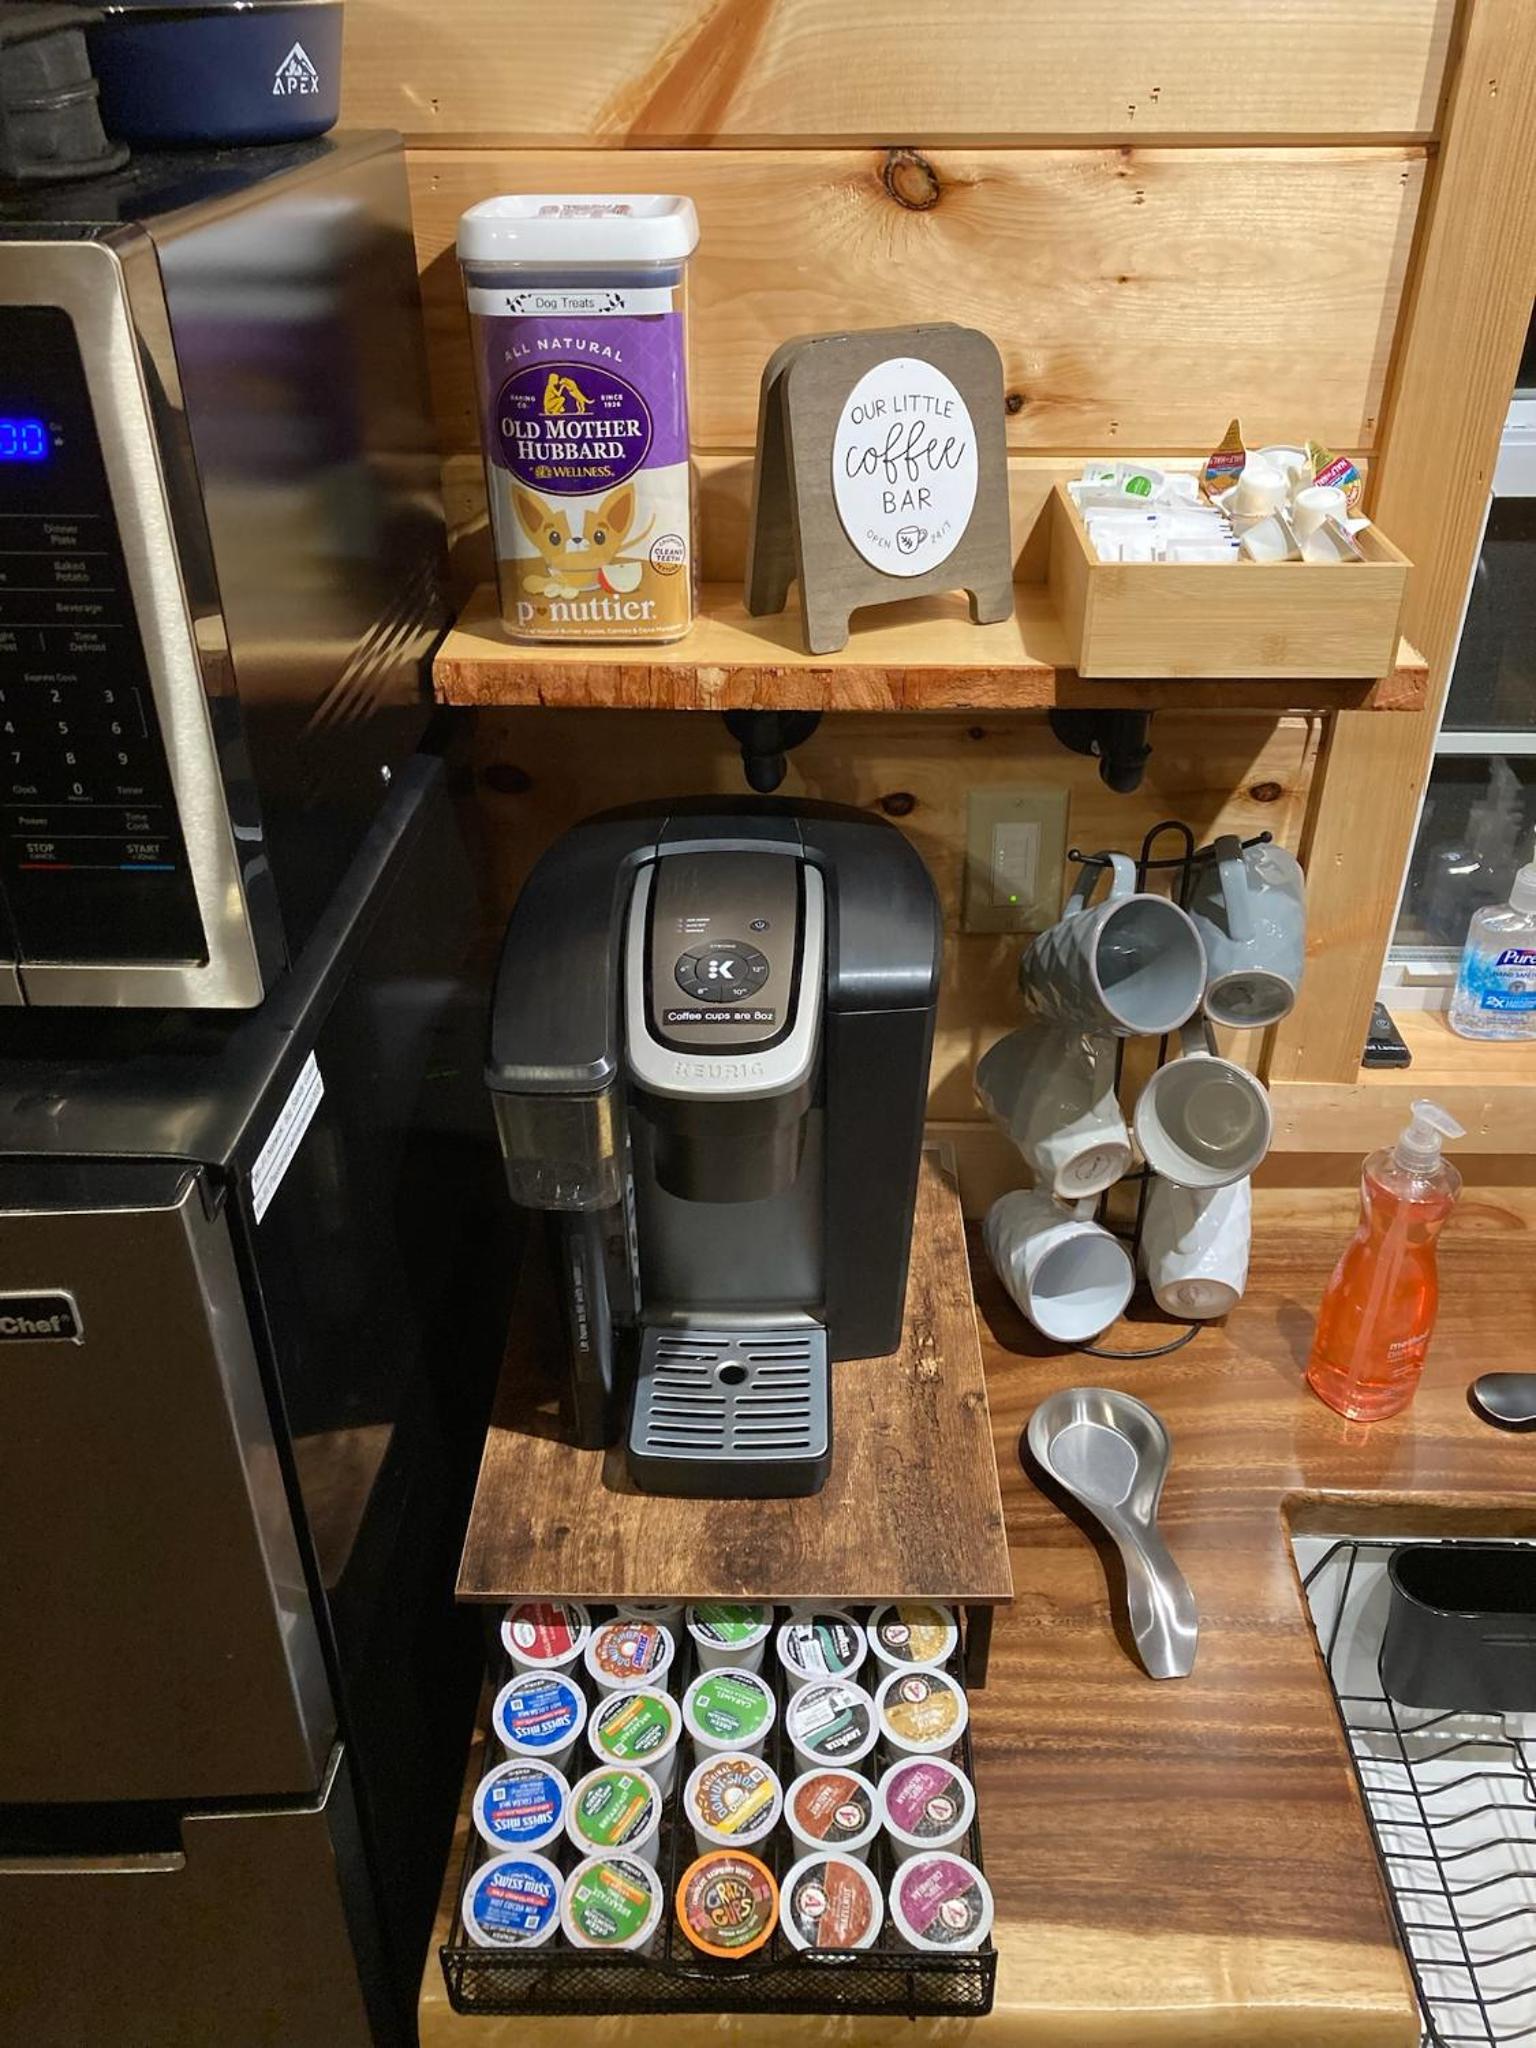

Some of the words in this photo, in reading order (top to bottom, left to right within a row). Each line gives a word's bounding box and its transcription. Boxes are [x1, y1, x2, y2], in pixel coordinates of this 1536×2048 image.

[272, 75, 319, 95] APEX
[535, 297, 558, 311] Dog
[560, 297, 595, 309] Treats
[504, 344, 531, 362] ALL
[537, 337, 623, 363] NATURAL
[851, 399, 887, 425] OUR
[893, 394, 955, 419] LITTLE
[502, 417, 540, 440] OLD
[545, 419, 642, 440] MOTHER
[846, 420, 966, 485] coffee
[882, 487, 933, 514] BAR
[866, 528, 892, 550] OPEN
[56, 603, 103, 614] Beverage
[50, 690, 61, 702] 2
[104, 690, 114, 703] 3
[4, 721, 15, 733] 4
[59, 722, 68, 734] 5
[112, 722, 121, 734] 6
[12, 752, 21, 764] 7
[66, 753, 76, 765] 8
[119, 753, 128, 765] 9
[12, 786, 38, 795] Clock
[73, 783, 83, 795] 0
[127, 822, 150, 831] Cook
[26, 844, 55, 853] STOP
[126, 844, 160, 853] START
[668, 1012, 702, 1021] Coffee
[705, 1013, 731, 1022] cups
[734, 1012, 751, 1021] are
[675, 1061, 765, 1080] KEURIG
[0, 1315, 61, 1334] Chef
[714, 1691, 752, 1708] CARAMEL
[702, 1766, 731, 1790] ORIGINAL
[498, 1800, 511, 1808] MIX
[511, 1797, 532, 1806] COCOA
[710, 1779, 727, 1818] DONUT
[727, 1773, 756, 1790] SHOP
[521, 1810, 554, 1826] SWISS
[597, 1790, 630, 1829] BREAKFAST
[491, 1815, 521, 1831] MISS
[490, 1872, 523, 1891] SWISS
[523, 1880, 551, 1897] MISS
[590, 1887, 632, 1917] BREAKFAST
[706, 1881, 748, 1908] CRAZY
[490, 1898, 503, 1907] HOT
[503, 1901, 524, 1912] COCOA
[524, 1905, 537, 1914] MIX
[711, 1898, 752, 1926] CUPS
[582, 1909, 617, 1932] MOUNTAIN
[584, 1918, 608, 1935] GREEN
